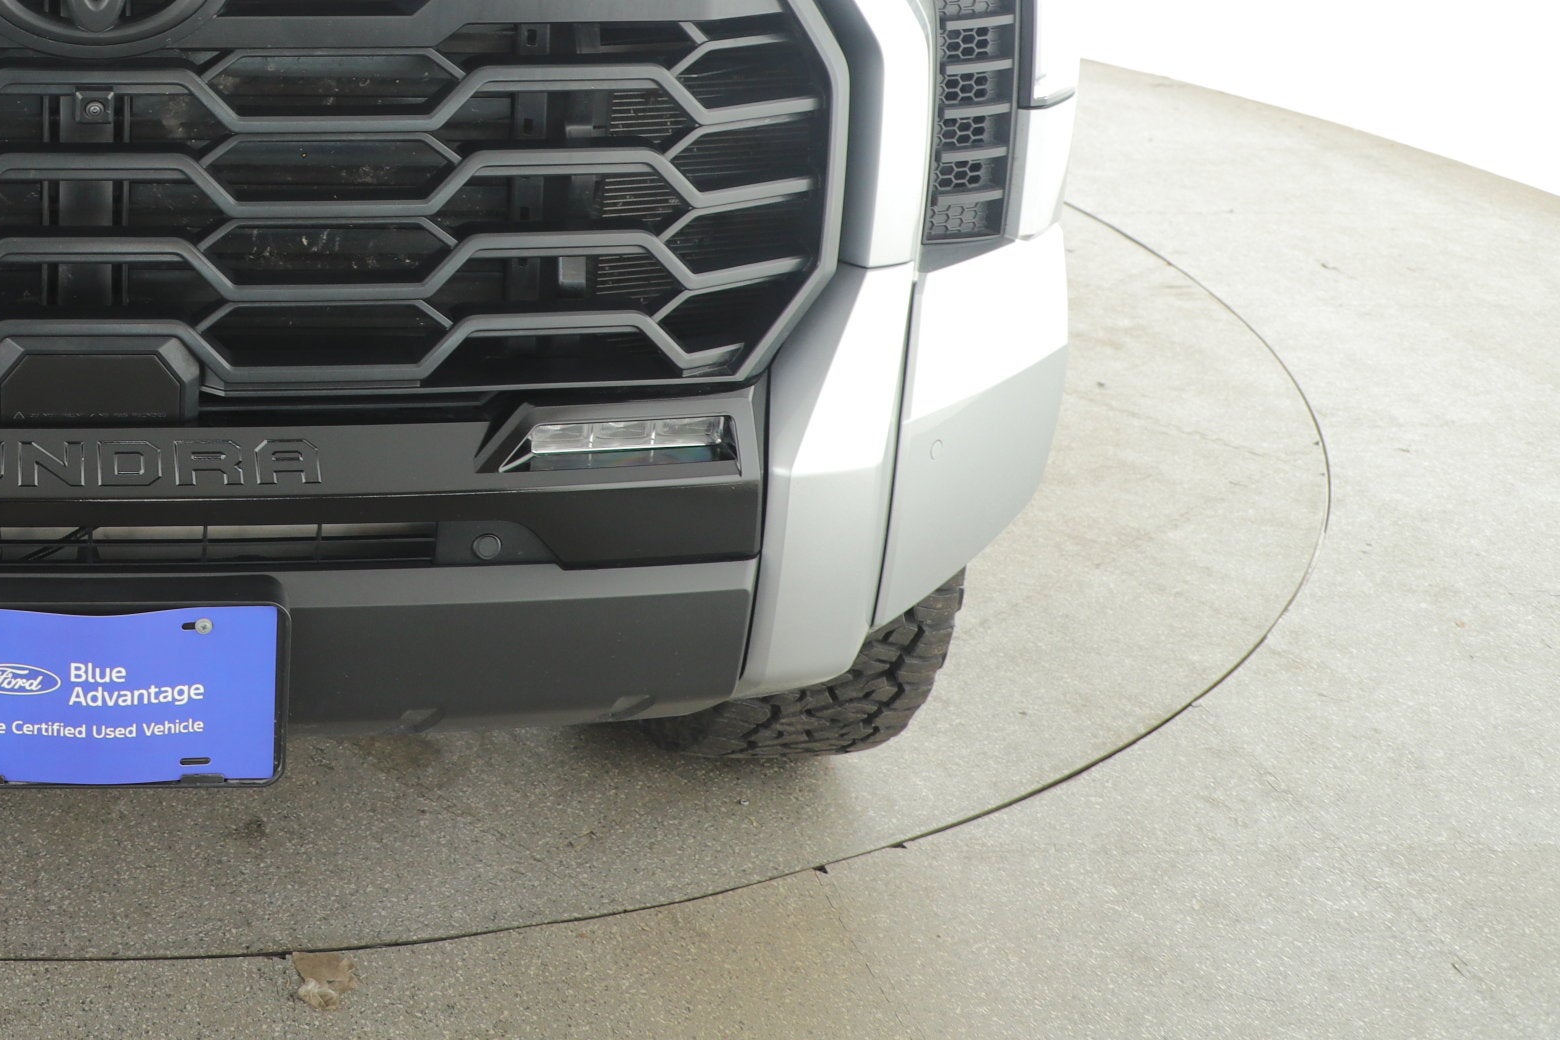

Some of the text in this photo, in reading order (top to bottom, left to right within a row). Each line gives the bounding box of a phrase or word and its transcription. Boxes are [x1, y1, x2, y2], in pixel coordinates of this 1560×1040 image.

[69, 662, 127, 683] Blue
[68, 682, 205, 707] Advantage
[11, 720, 86, 738] Certified
[92, 722, 137, 739] Used
[142, 717, 205, 737] Vehicle
